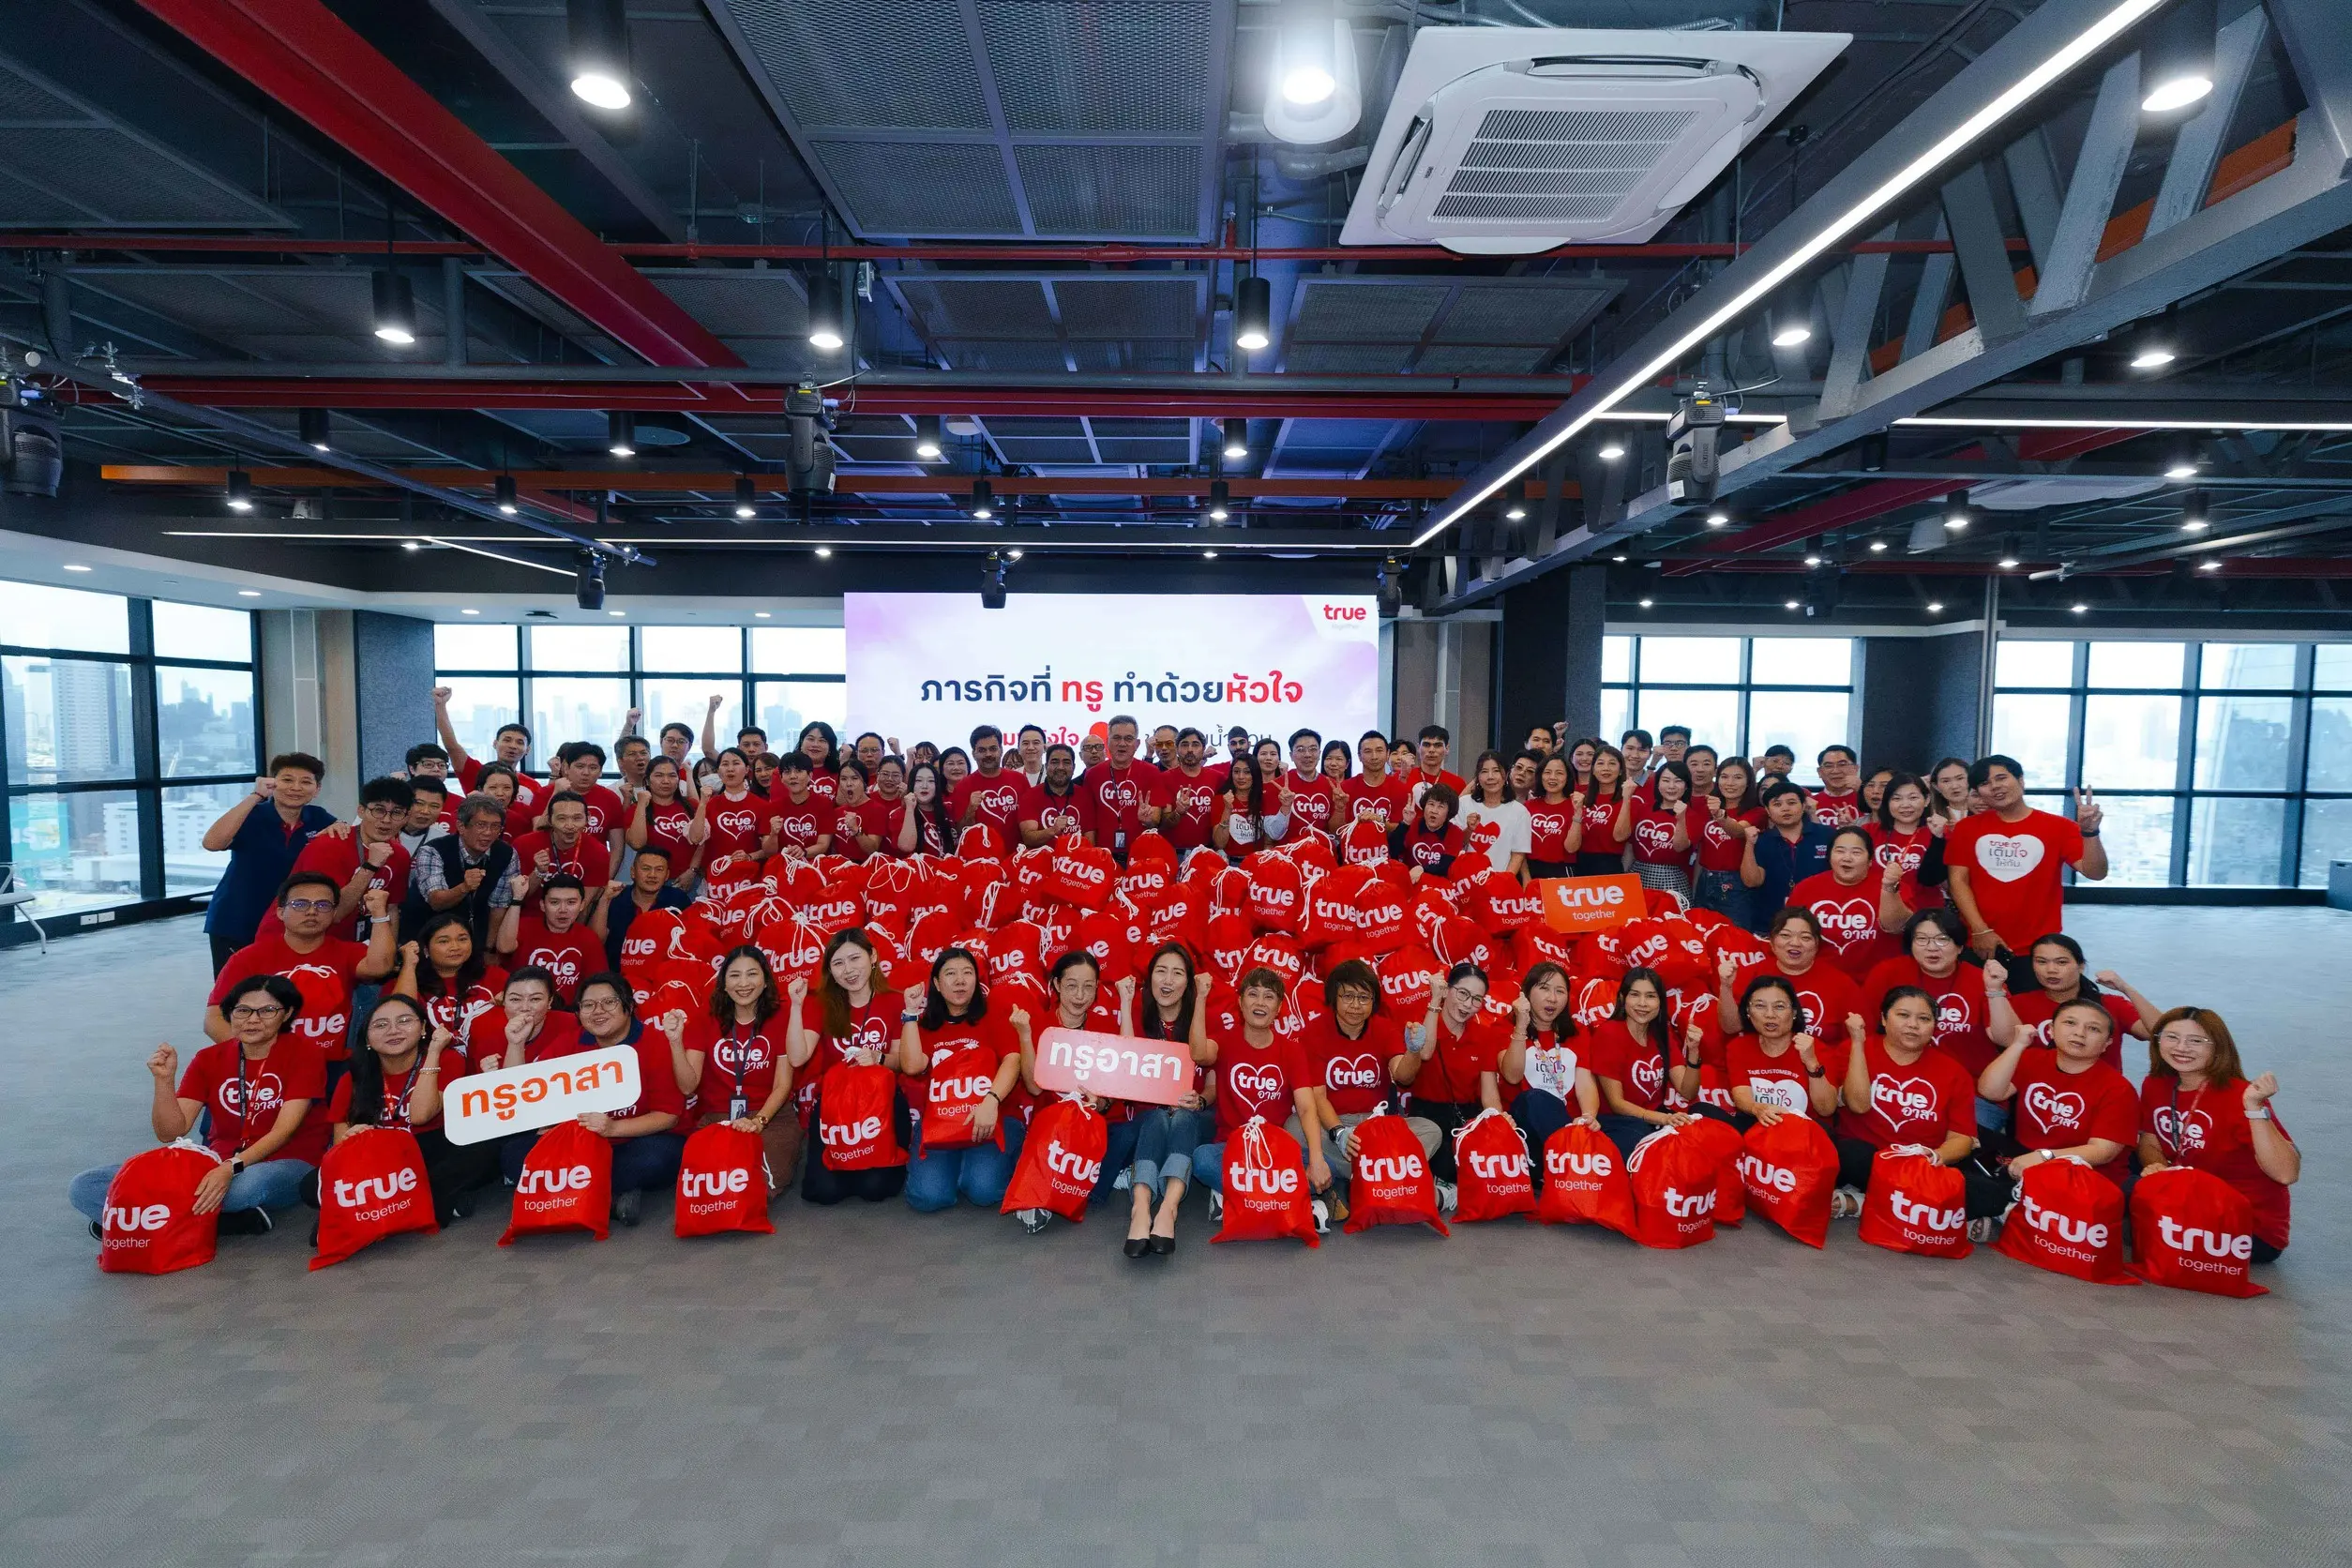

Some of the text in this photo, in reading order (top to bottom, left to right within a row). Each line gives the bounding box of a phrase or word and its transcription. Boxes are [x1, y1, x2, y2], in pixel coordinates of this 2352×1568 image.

[1324, 605, 1366, 620] true
[921, 665, 1303, 712] ภารกิจที่ ทรู ทำด้วยหัวใจ
[807, 783, 833, 794] rue
[985, 793, 1015, 807] true
[1189, 795, 1212, 806] rue
[1296, 800, 1326, 812] true
[722, 817, 752, 826] true
[789, 822, 812, 833] true
[1532, 818, 1559, 829] true
[1638, 824, 1669, 840] true
[1348, 844, 1389, 863] true
[1417, 847, 1441, 861] true
[1060, 856, 1106, 883] true
[1061, 876, 1092, 891] together
[1122, 873, 1165, 892] true
[1249, 881, 1294, 906] true
[1557, 885, 1624, 907] true
[809, 900, 856, 920] true
[1254, 905, 1287, 916] together
[1315, 897, 1357, 923] true
[1355, 903, 1403, 928] true
[1573, 910, 1616, 922] together
[1817, 911, 1867, 929] true
[821, 917, 851, 928] ogether
[1501, 915, 1530, 926] together
[1365, 924, 1401, 939] together
[1842, 928, 1877, 940] อาสา
[771, 946, 821, 972] true
[989, 949, 1025, 974] rue
[1253, 944, 1301, 972] true
[1627, 934, 1668, 969] true
[1382, 970, 1432, 994] true
[291, 1013, 346, 1037] rue
[1937, 1022, 1971, 1033] อาสา
[1049, 1041, 1182, 1080] ทรูอาสา
[1237, 1071, 1277, 1091] true
[1333, 1066, 1376, 1084] true
[461, 1060, 624, 1121] ทรูอาสา
[928, 1076, 992, 1103] true
[1258, 1090, 1282, 1100] อาสา
[1876, 1083, 1928, 1108] true
[937, 1101, 982, 1117] togethe
[2032, 1090, 2073, 1117] true
[1902, 1106, 1937, 1123] อาสา
[2051, 1114, 2080, 1130] อาสา
[820, 1116, 882, 1145] true
[831, 1144, 875, 1162] together
[1048, 1139, 1102, 1184] true
[1545, 1149, 1612, 1176] true
[1360, 1153, 1424, 1182] true
[1469, 1150, 1530, 1178] true
[334, 1167, 417, 1208] true
[517, 1163, 592, 1194] true
[682, 1168, 749, 1198] true
[1051, 1176, 1091, 1198] together
[1229, 1161, 1298, 1194] true
[1555, 1179, 1604, 1191] together
[1372, 1184, 1418, 1200] together
[1487, 1184, 1530, 1196] together
[354, 1197, 413, 1222] together
[523, 1196, 579, 1213] together
[689, 1199, 738, 1215] together
[1244, 1197, 1291, 1213] together
[1664, 1186, 1717, 1217] true
[1890, 1189, 1967, 1230] true
[1678, 1217, 1711, 1234] together
[2023, 1195, 2108, 1248] true
[1903, 1227, 1957, 1245] together
[2158, 1215, 2253, 1259] true
[2034, 1233, 2098, 1264] together
[2178, 1256, 2243, 1276] together
